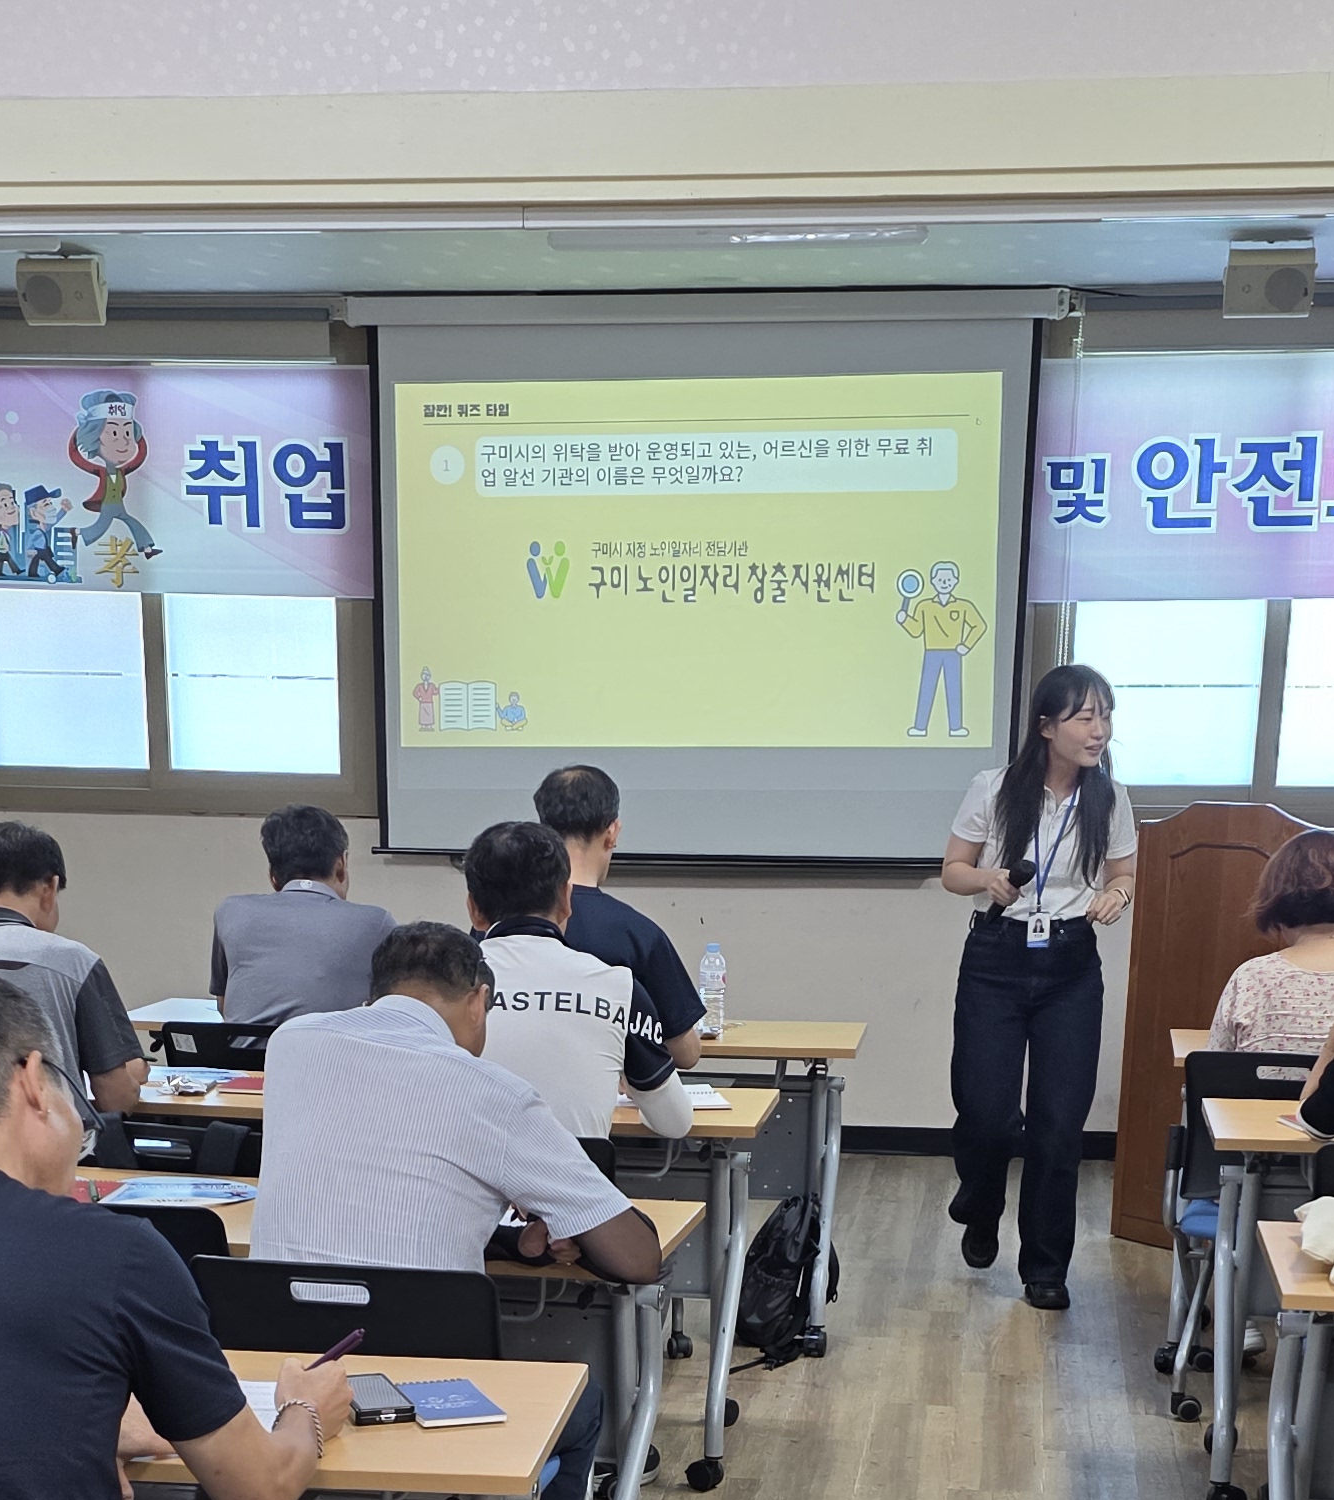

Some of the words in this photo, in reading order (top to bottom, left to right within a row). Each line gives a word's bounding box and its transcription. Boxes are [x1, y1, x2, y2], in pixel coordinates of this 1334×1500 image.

[108, 403, 127, 417] 취업
[423, 404, 452, 418] 잠깐!
[457, 403, 481, 418] 퀴즈
[486, 403, 510, 417] 타임
[480, 443, 547, 463] 구미시의
[552, 442, 602, 463] 위탁을
[608, 441, 641, 462] 받아
[646, 440, 713, 461] 운영되고
[719, 439, 757, 461] 있는,
[763, 438, 831, 460] 어르신을
[836, 437, 871, 458] 위한
[876, 437, 910, 457] 무료
[916, 436, 933, 457] 취
[442, 458, 451, 473] 1
[481, 467, 496, 487] 업
[503, 467, 535, 487] 알선
[541, 466, 590, 486] 기관의
[596, 465, 646, 486] 이름은
[651, 465, 744, 486] 무엇일까요?
[184, 438, 348, 531] 취업
[1044, 457, 1108, 527] 및
[94, 535, 140, 588] 孝
[591, 542, 623, 558] 구미시
[626, 542, 646, 558] 지정
[650, 541, 702, 558] 노인일자리
[705, 540, 748, 558] 전담기관
[588, 564, 629, 599] 구미
[636, 563, 740, 603] 노인일자리
[747, 561, 876, 603] 창출지원센터
[492, 991, 663, 1045] ASTELBAJAC
